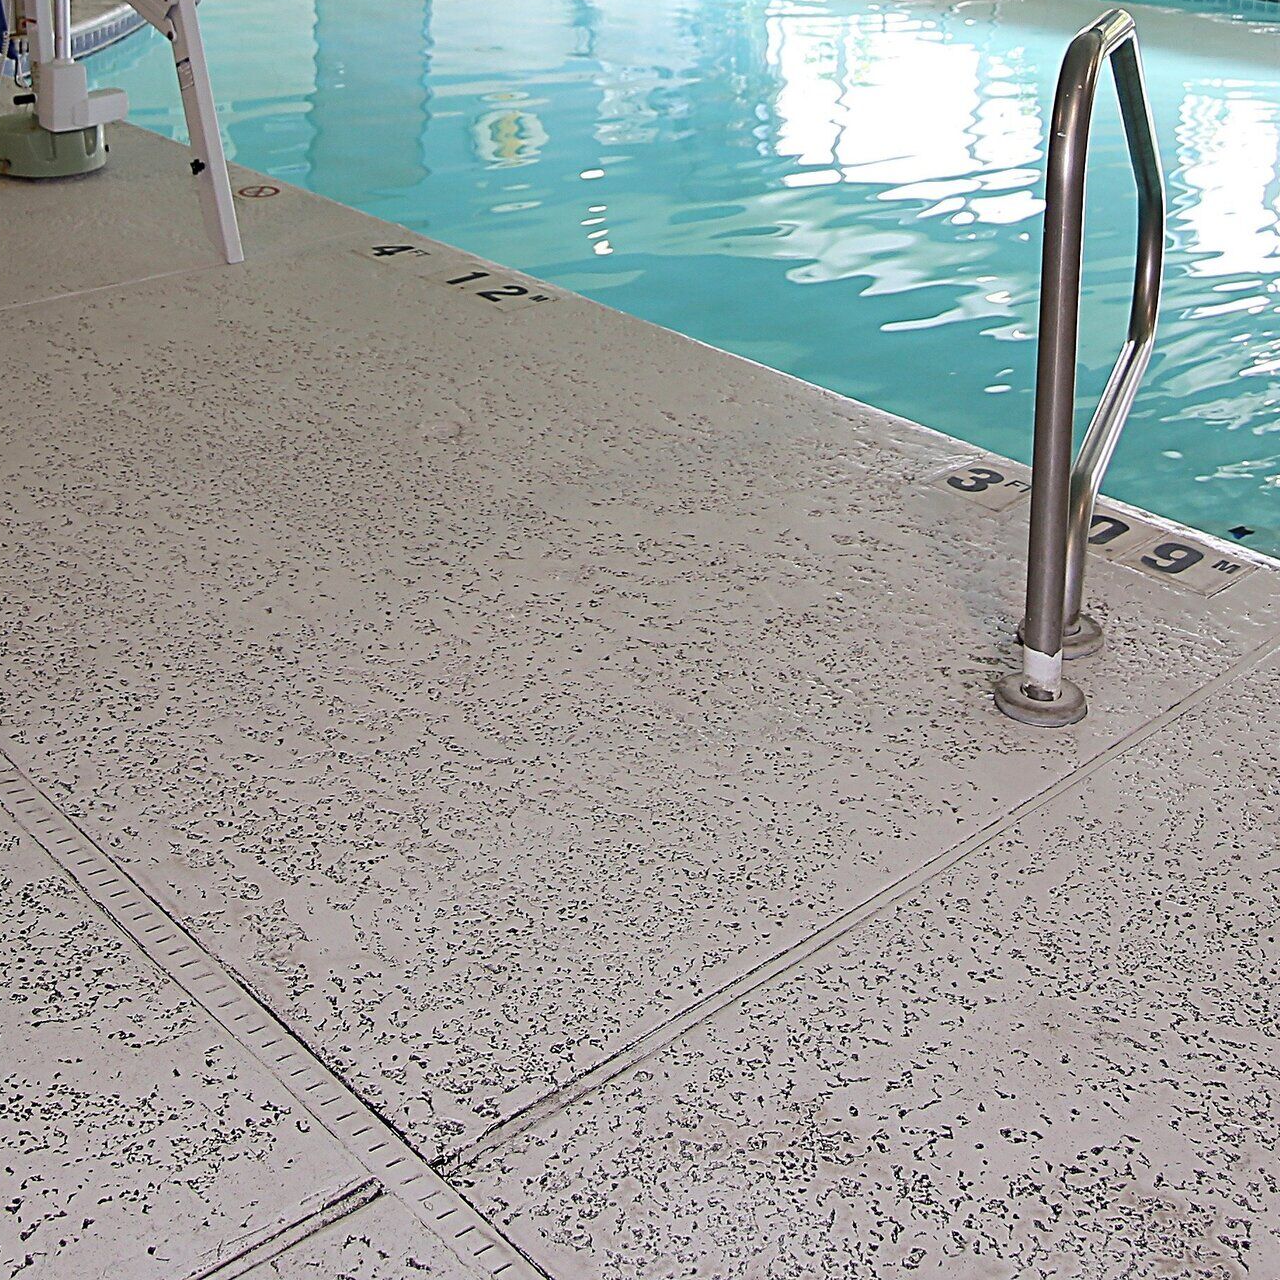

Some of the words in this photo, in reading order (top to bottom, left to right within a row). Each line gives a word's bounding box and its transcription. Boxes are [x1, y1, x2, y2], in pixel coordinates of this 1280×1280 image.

[372, 245, 415, 257] 4
[947, 468, 1004, 492] 3
[1211, 559, 1241, 575] M
